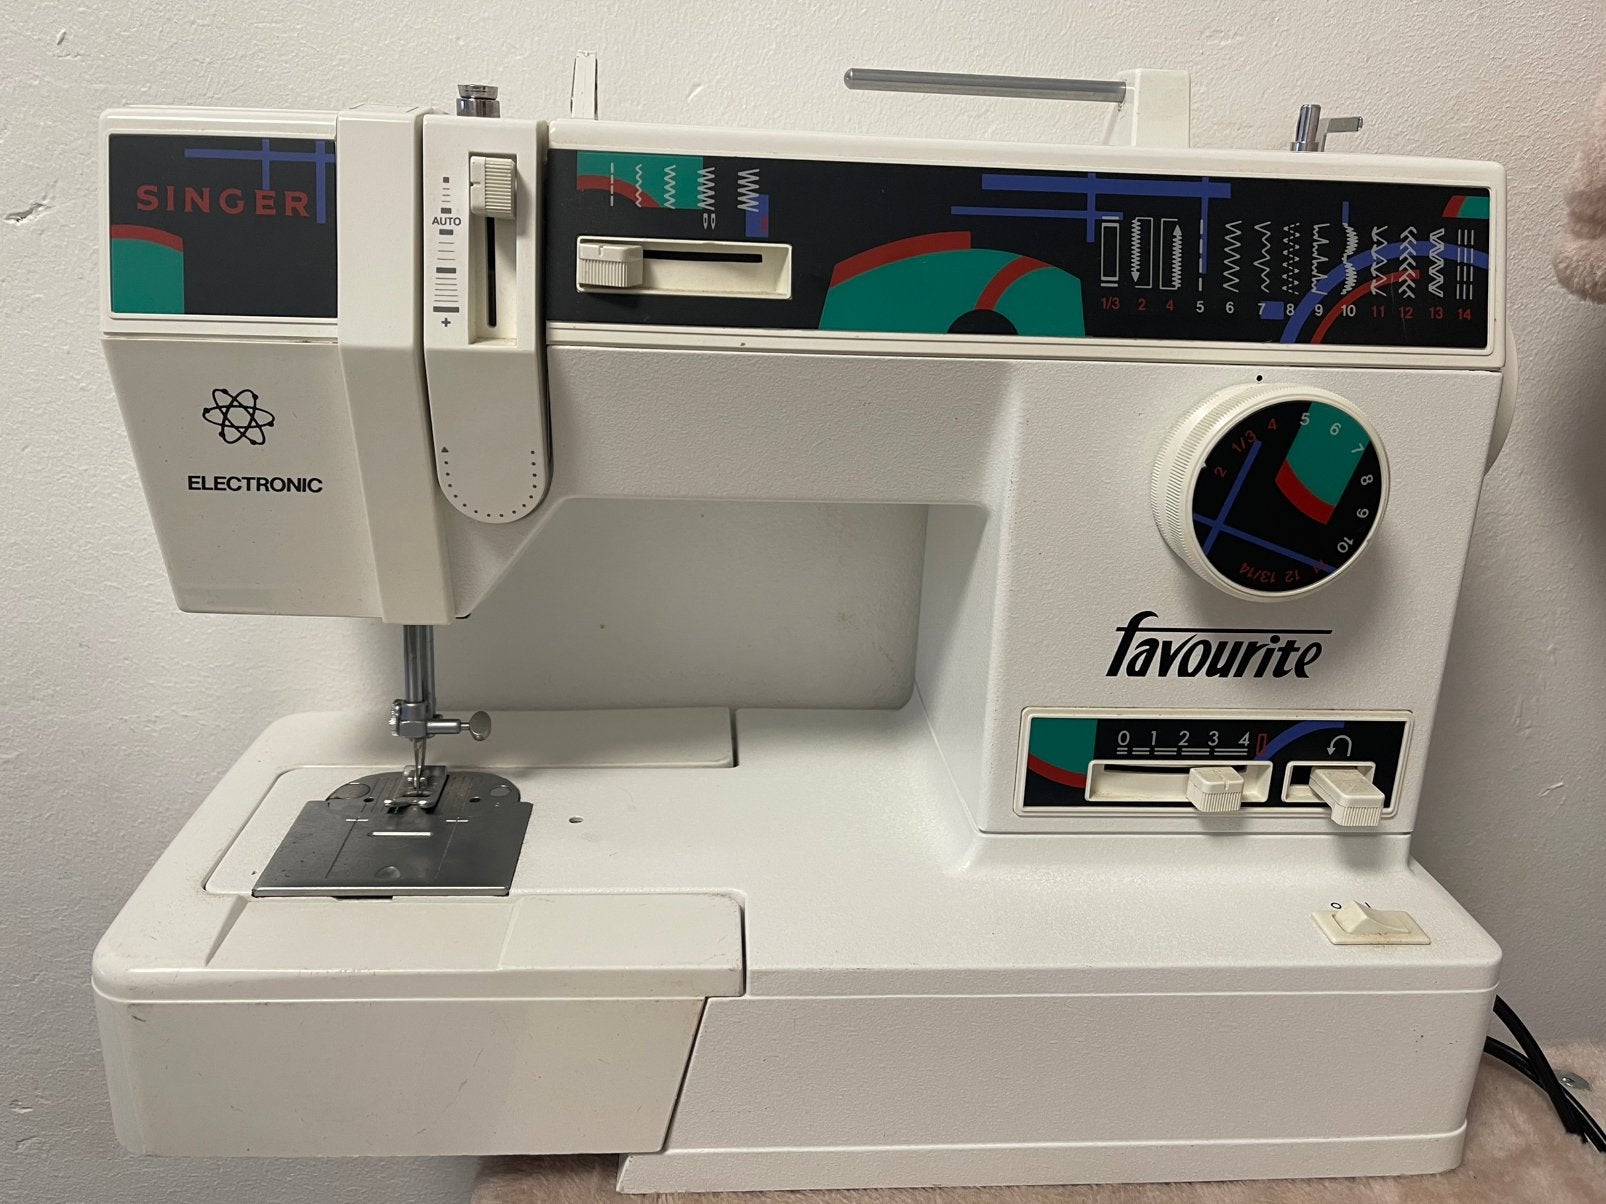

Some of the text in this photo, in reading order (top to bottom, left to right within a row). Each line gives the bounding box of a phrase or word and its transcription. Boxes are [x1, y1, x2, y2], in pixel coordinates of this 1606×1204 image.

[136, 184, 310, 217] SINGER
[432, 216, 462, 226] AUTO
[1101, 297, 1472, 321] 1/3 2 4 5 6 7 8 9 10 11 12 13 14
[1267, 418, 1277, 430] 4
[1300, 413, 1310, 425] 5
[1330, 423, 1341, 435] 6
[1231, 430, 1257, 453] 1/3
[1351, 443, 1366, 454] 7
[1214, 466, 1228, 477] 2
[187, 475, 323, 493] ELECTRONIC
[1361, 474, 1373, 485] 8
[1356, 508, 1369, 518] 9
[1337, 537, 1353, 553] 10
[1239, 562, 1278, 583] 13/14
[1285, 570, 1301, 583] 12
[1105, 610, 1333, 679] favourite
[1118, 731, 1250, 747] 0 1 2 3 4
